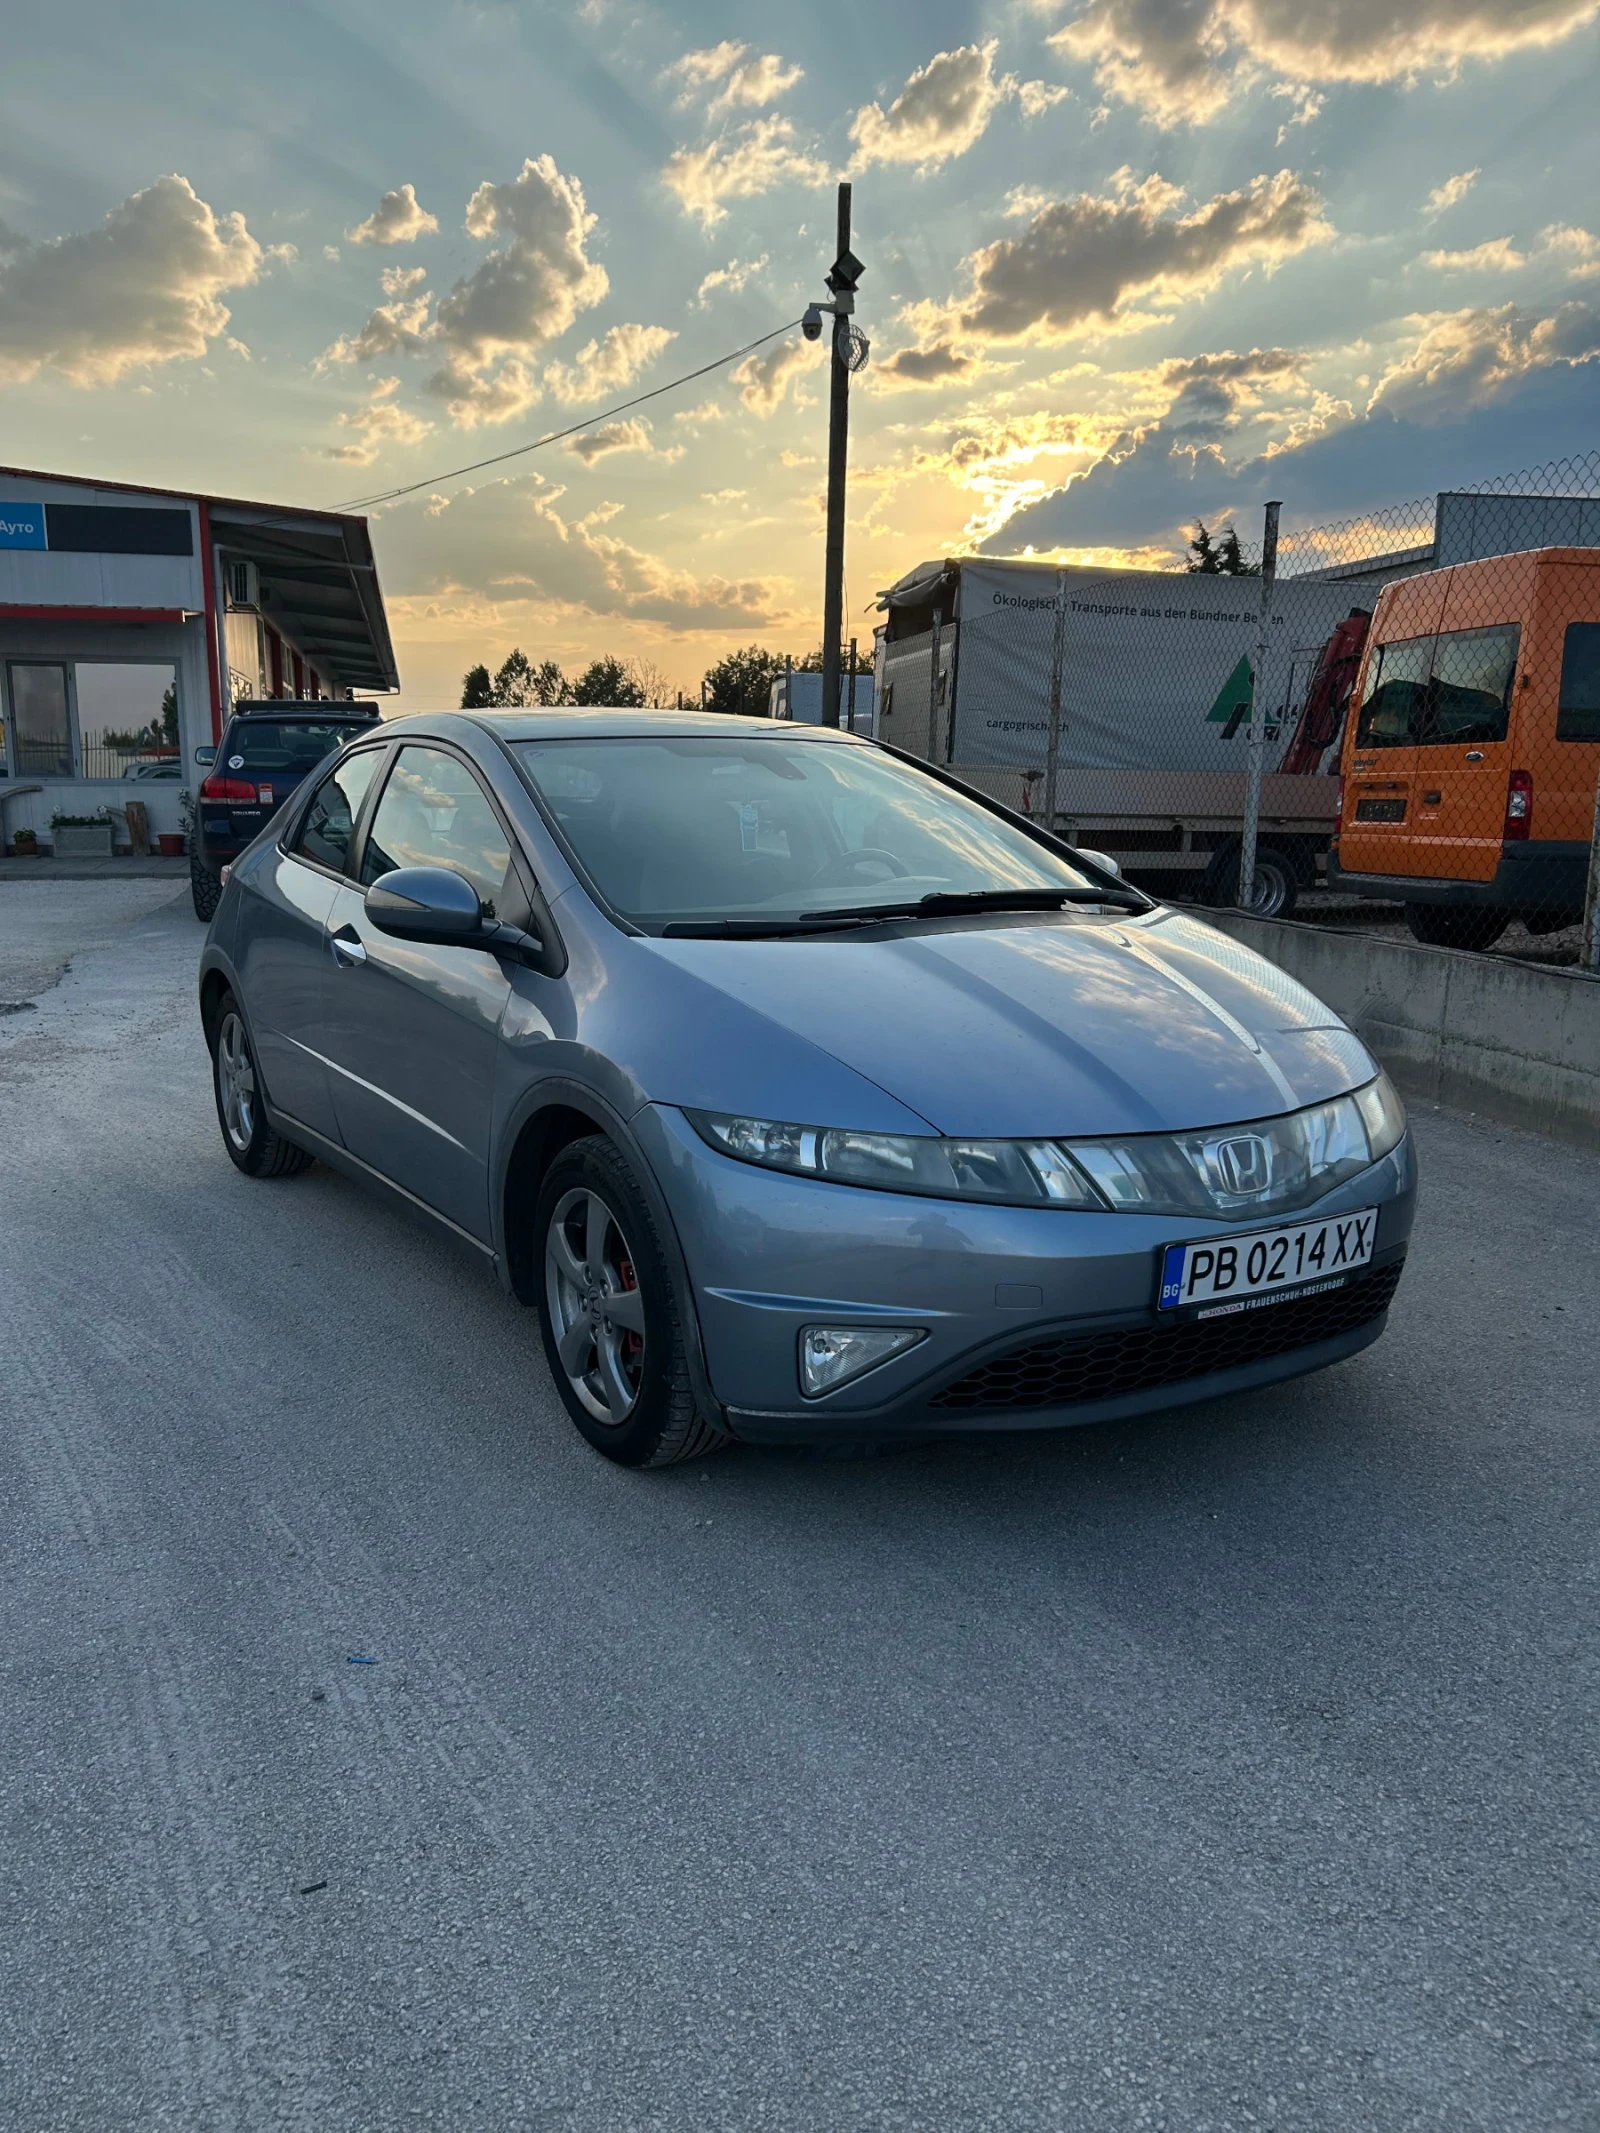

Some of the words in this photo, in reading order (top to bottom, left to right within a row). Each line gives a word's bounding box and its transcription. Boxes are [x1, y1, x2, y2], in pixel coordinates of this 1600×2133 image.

[1071, 600, 1137, 617] Transporte
[1140, 607, 1161, 618] aus
[1164, 607, 1186, 619] den
[1190, 609, 1240, 622] Bündner
[1243, 612, 1284, 625] Been
[1162, 1283, 1179, 1298] BG
[1187, 1245, 1238, 1296] PB
[1246, 1227, 1327, 1285] 0214
[1331, 1216, 1371, 1267] XX
[1208, 1303, 1243, 1316] HONDA
